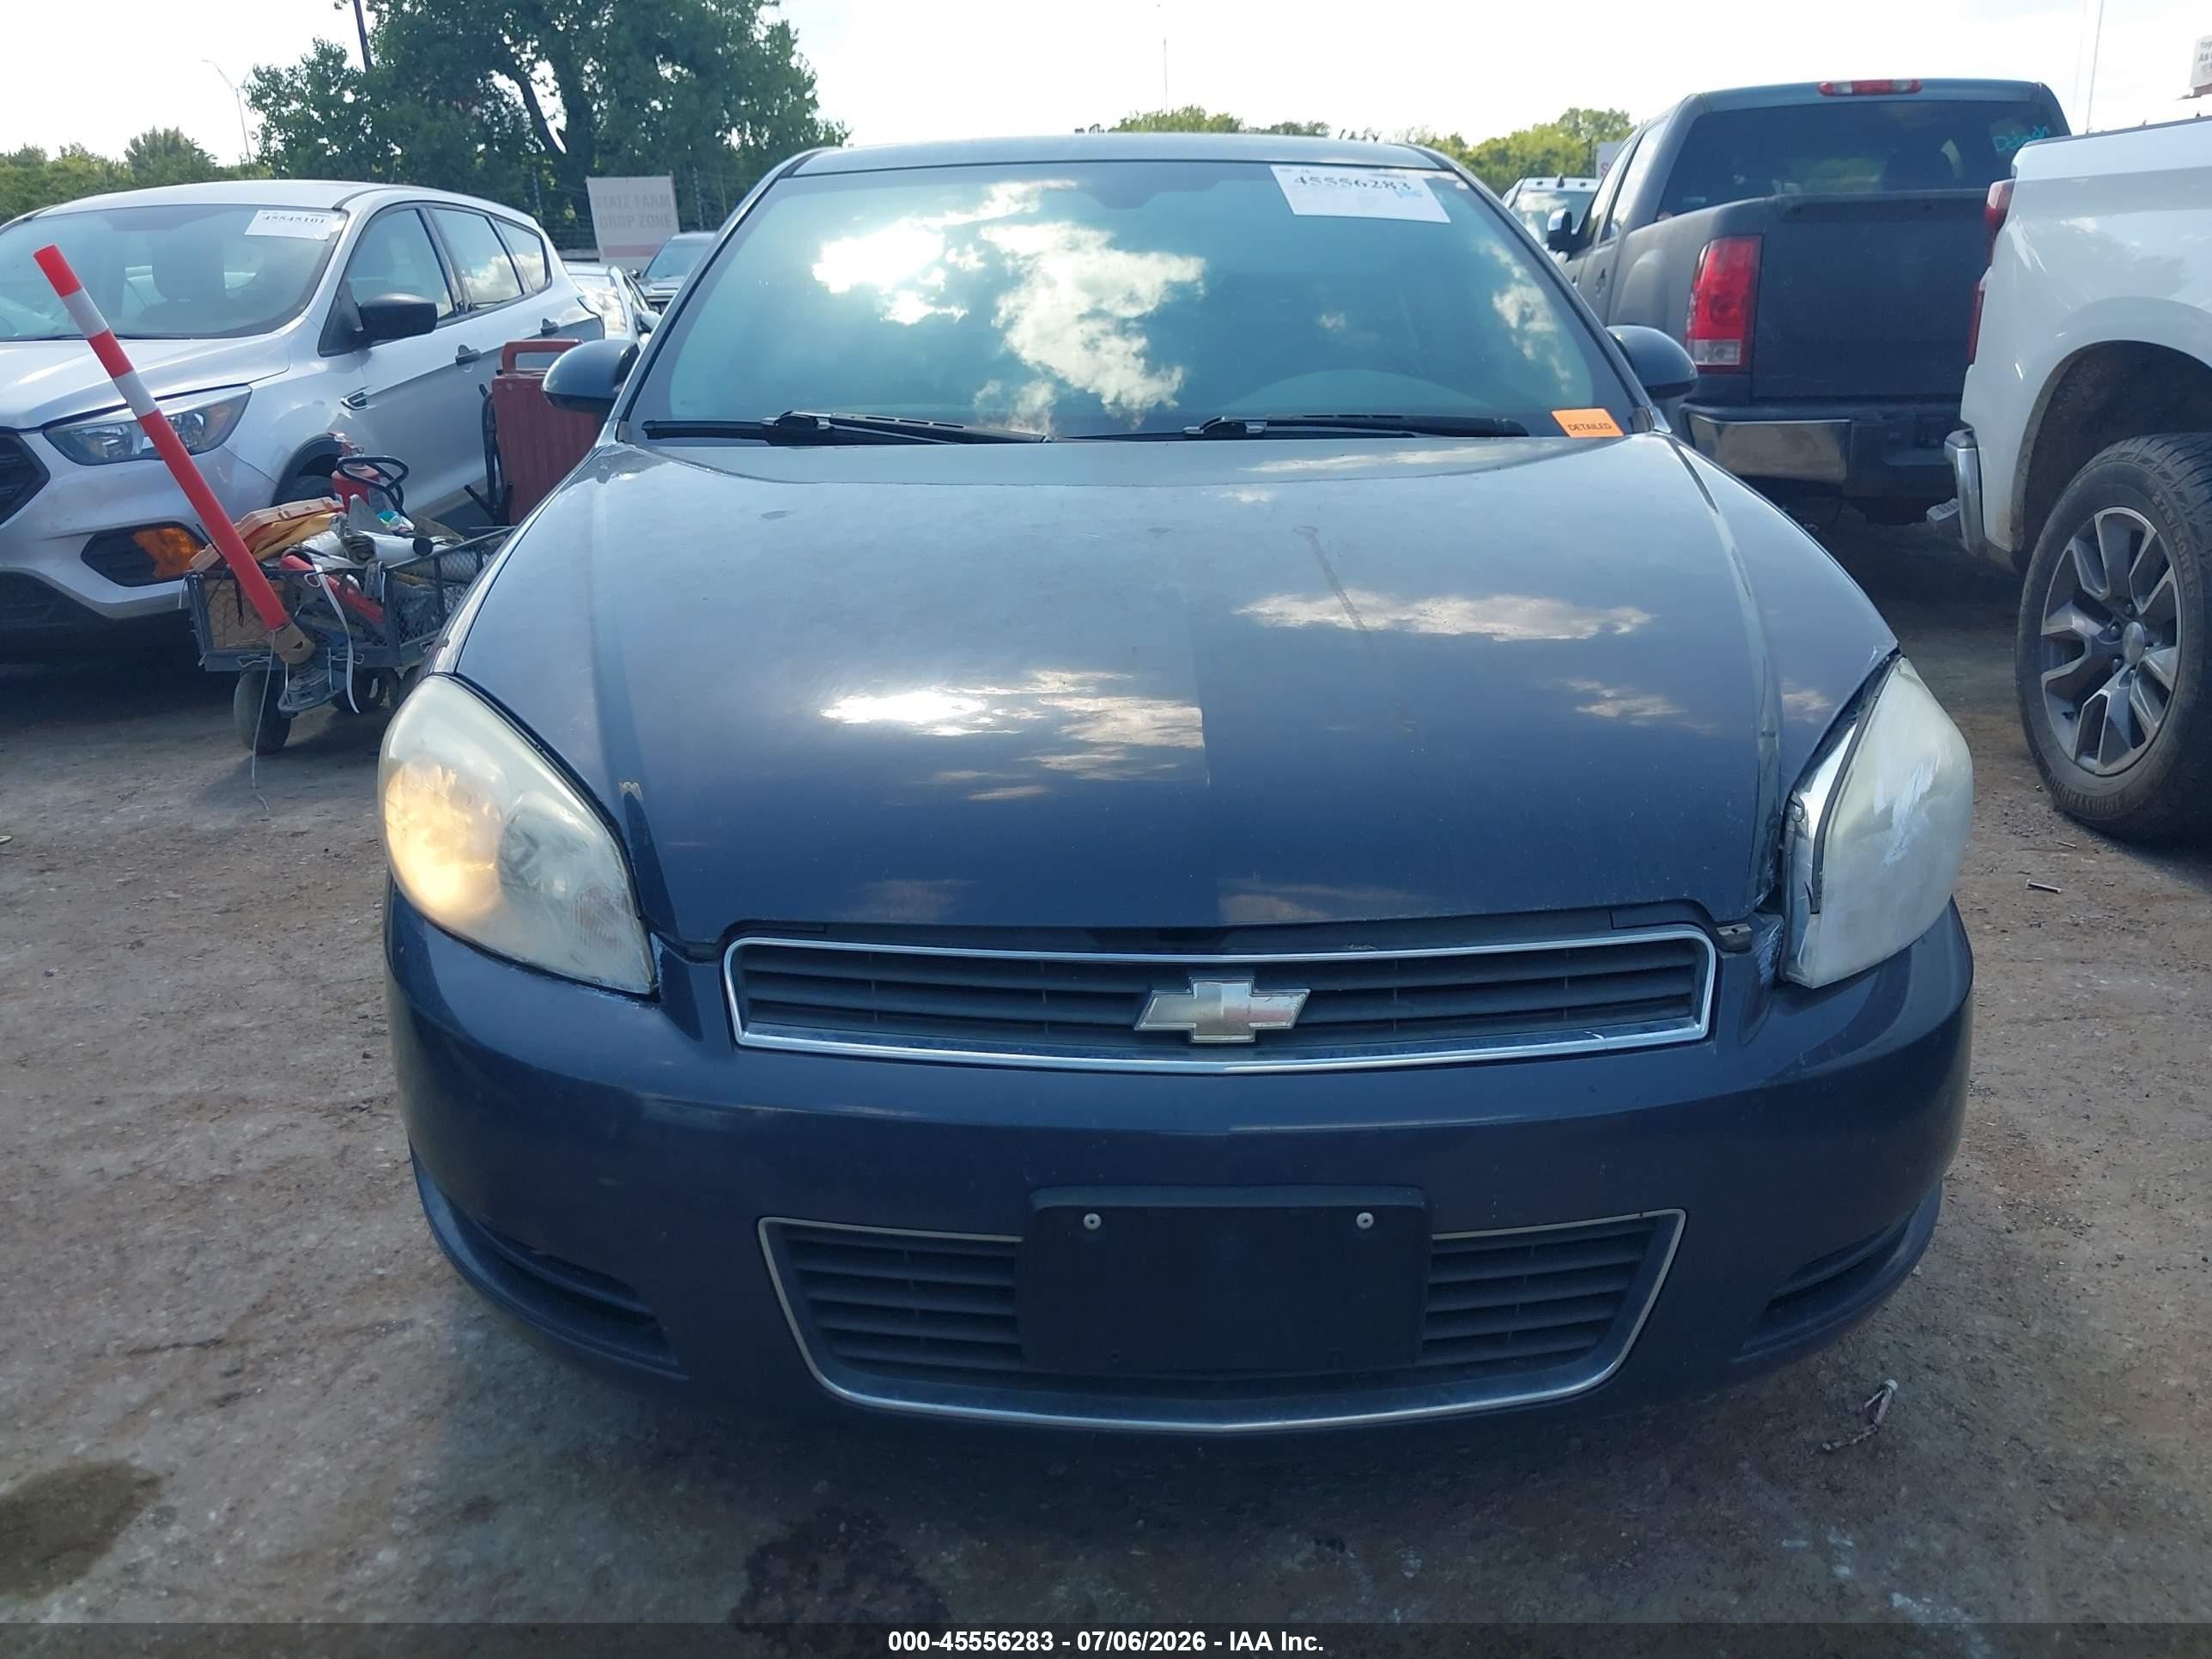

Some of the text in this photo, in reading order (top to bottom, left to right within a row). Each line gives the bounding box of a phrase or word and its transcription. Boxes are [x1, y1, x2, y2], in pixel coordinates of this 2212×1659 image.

[1294, 176, 1412, 191] 45556283
[593, 193, 672, 209] STATE FARM
[599, 214, 673, 230] DROP ZONE
[1567, 422, 1612, 431] DETAILED
